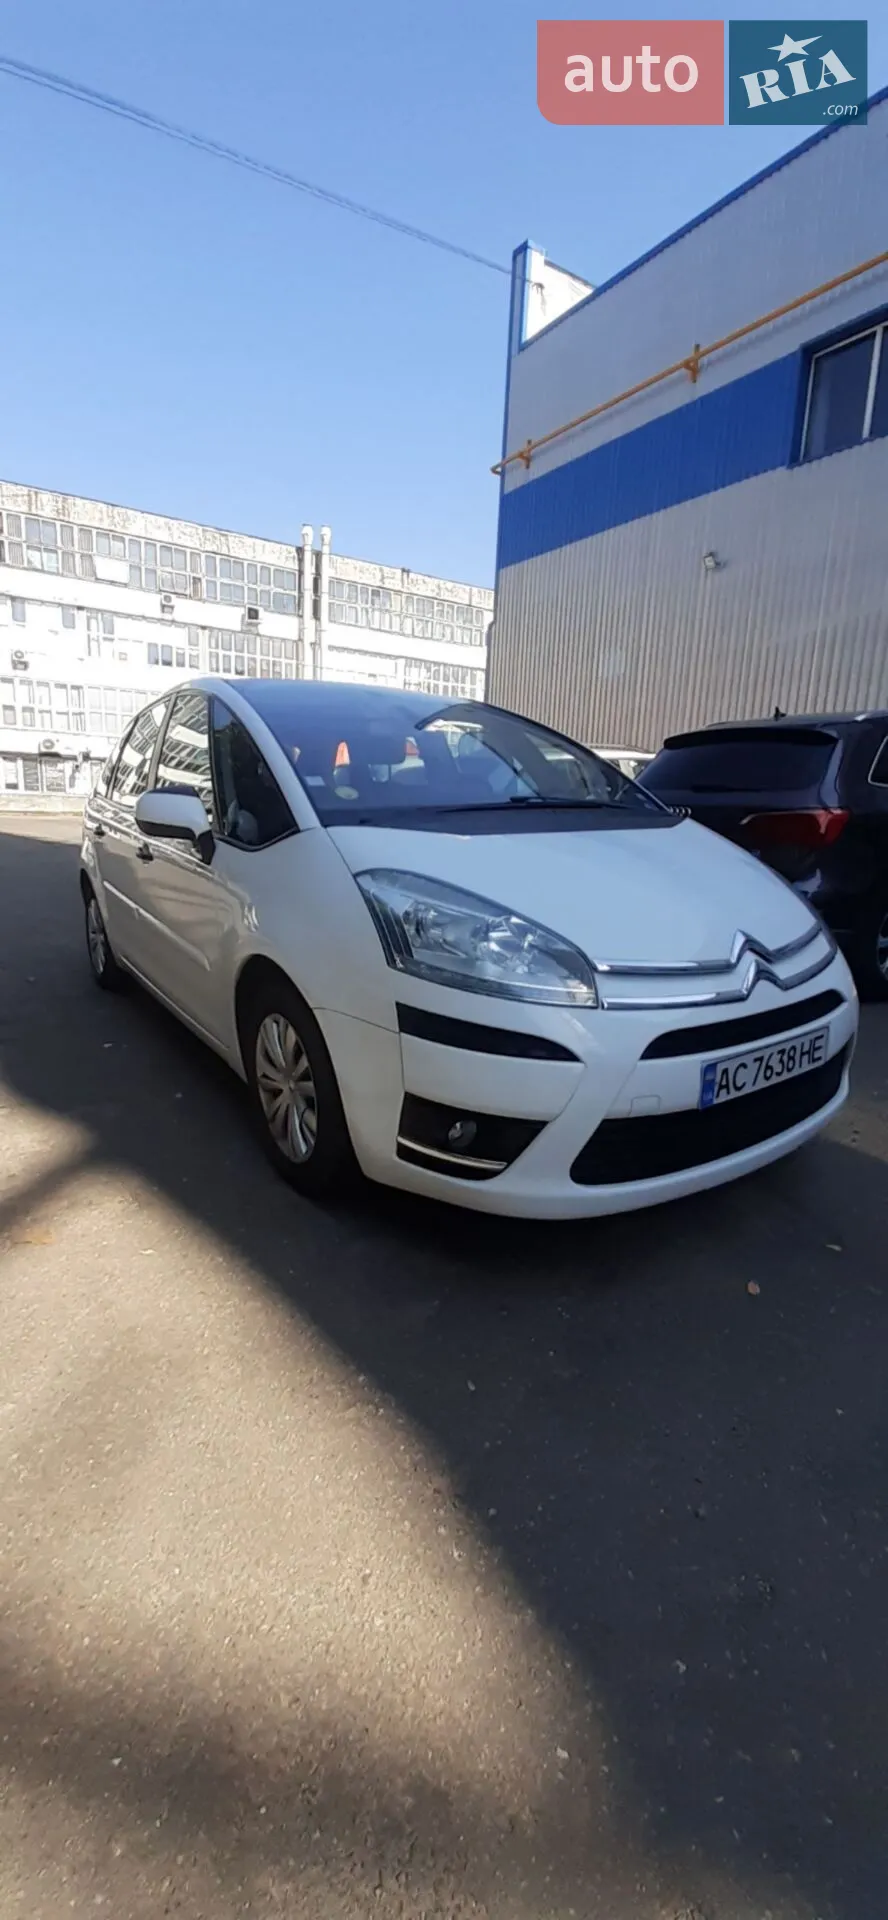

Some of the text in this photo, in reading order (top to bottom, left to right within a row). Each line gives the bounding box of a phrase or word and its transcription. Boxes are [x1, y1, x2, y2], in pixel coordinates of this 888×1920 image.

[715, 1034, 825, 1099] AC 7638 HE
